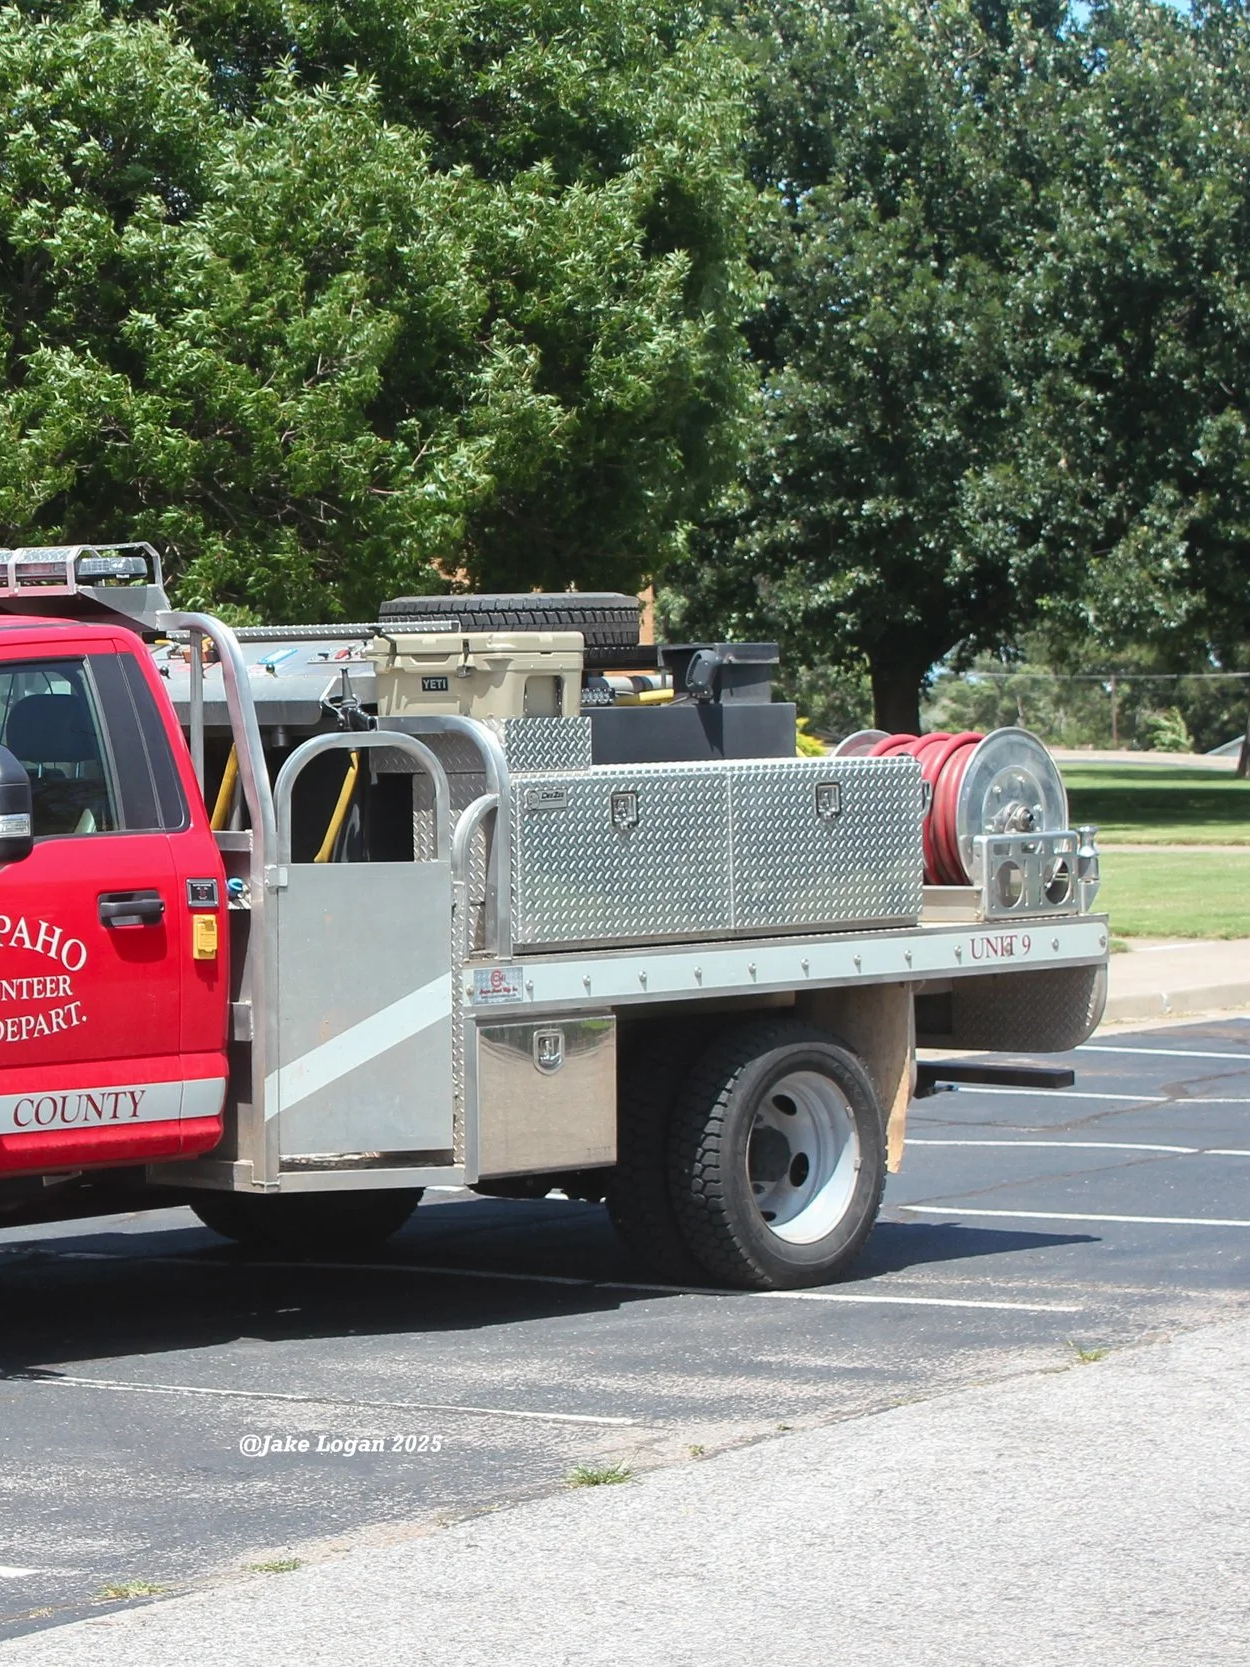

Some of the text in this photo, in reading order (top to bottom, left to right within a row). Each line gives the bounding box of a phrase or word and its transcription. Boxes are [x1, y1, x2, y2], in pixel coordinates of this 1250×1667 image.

[422, 679, 446, 689] YETI
[969, 934, 1032, 960] UNIT 9
[12, 1089, 147, 1128] COUNTY
